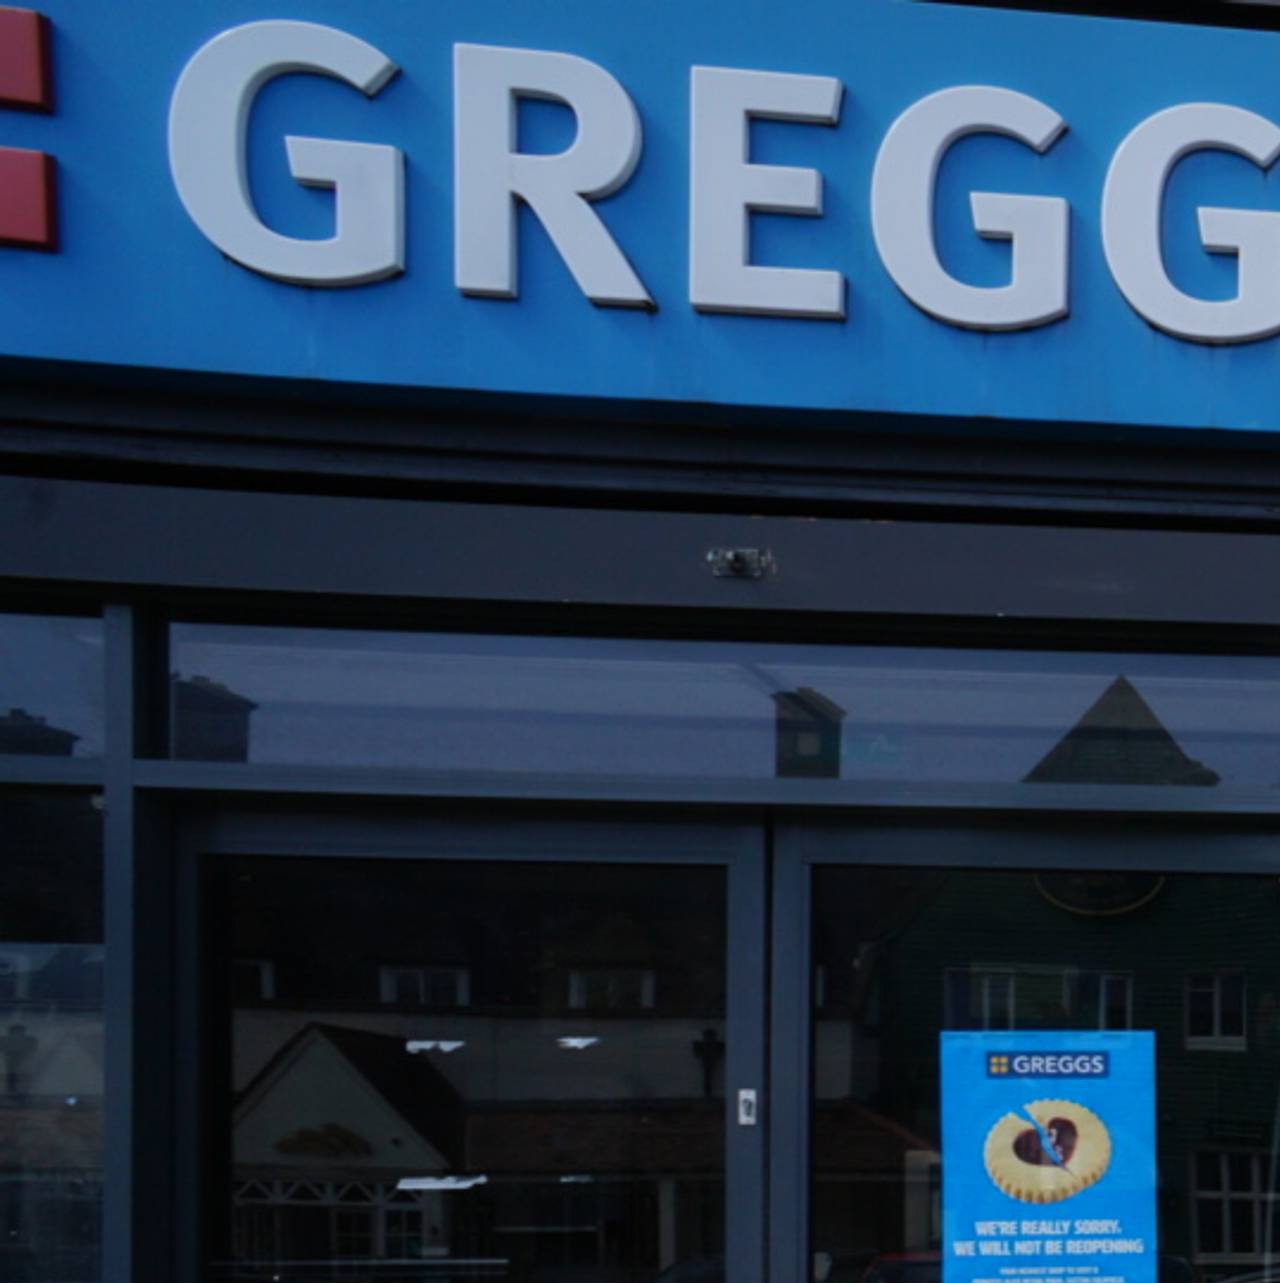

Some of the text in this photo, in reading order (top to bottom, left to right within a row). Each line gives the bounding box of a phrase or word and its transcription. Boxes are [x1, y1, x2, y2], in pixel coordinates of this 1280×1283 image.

[1012, 1055, 1104, 1074] GREGGS
[1021, 1220, 1070, 1234] REALLY
[953, 1239, 1144, 1256] WE WILL NOT BE REOPENING
